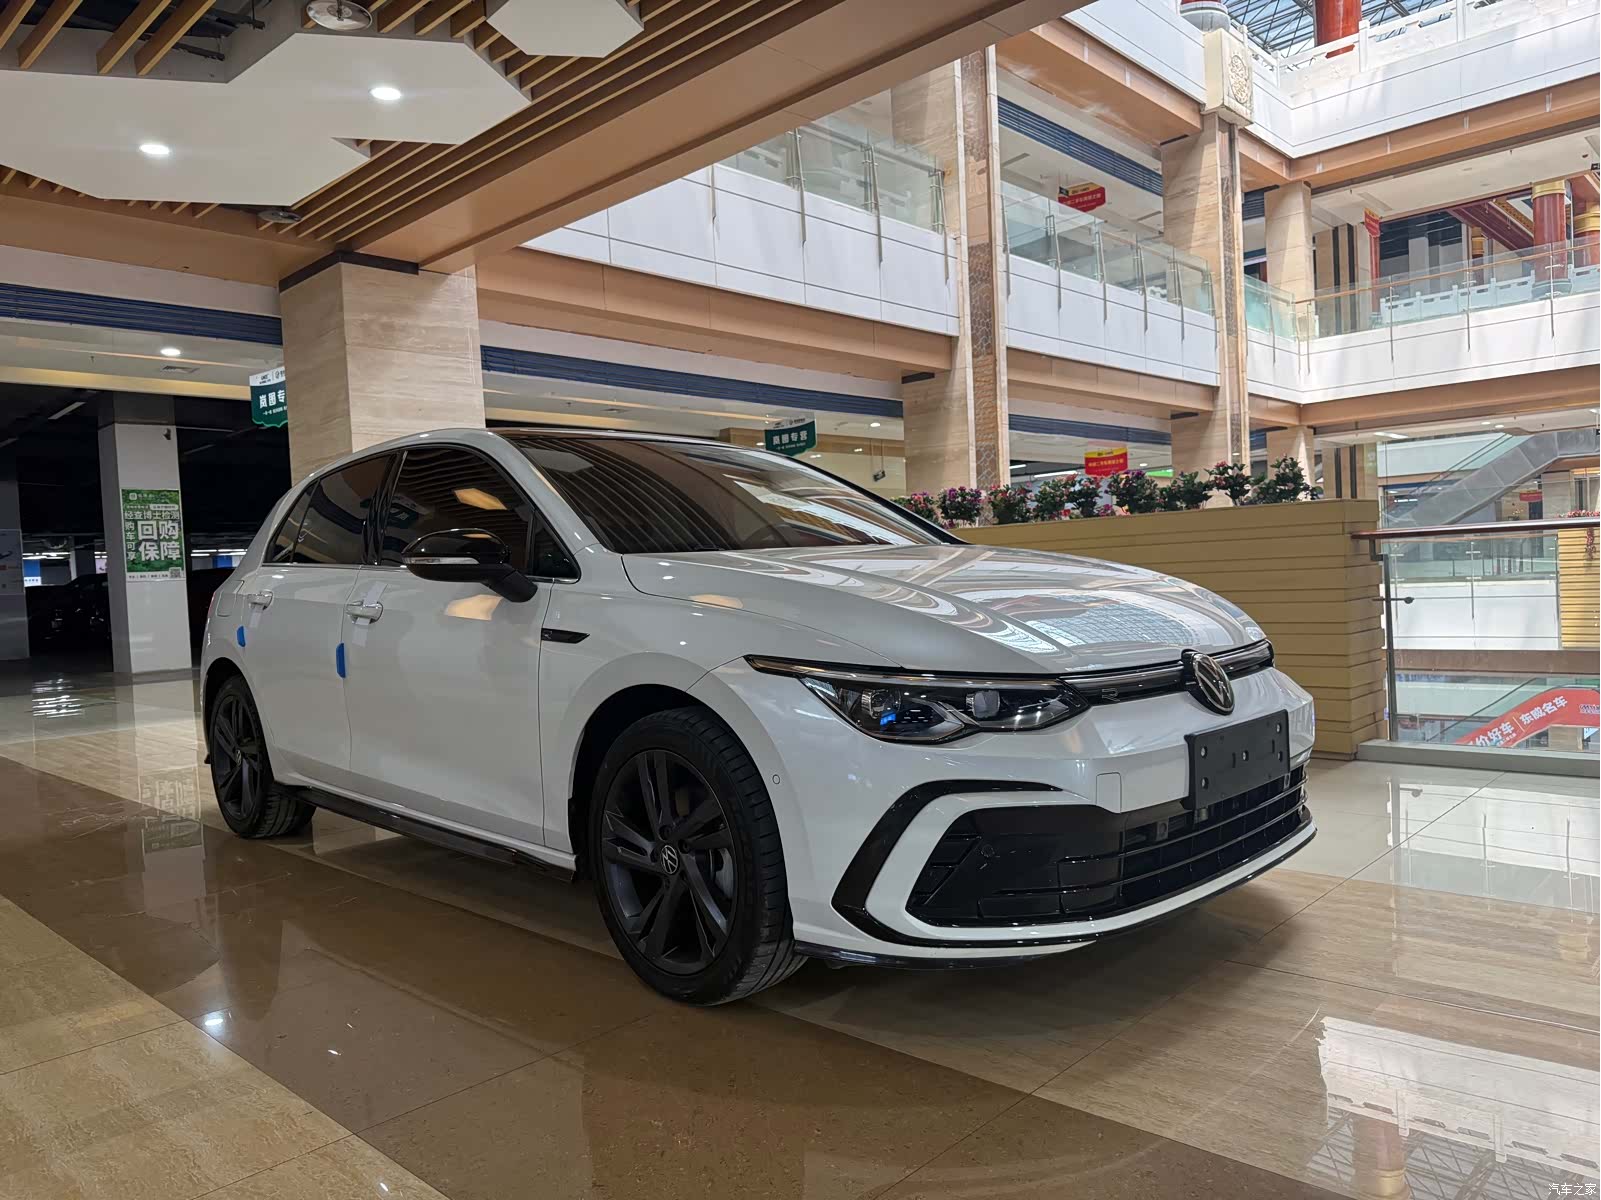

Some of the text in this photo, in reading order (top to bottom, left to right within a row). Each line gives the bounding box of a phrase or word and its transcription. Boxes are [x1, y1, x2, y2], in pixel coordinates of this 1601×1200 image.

[124, 510, 180, 520] 经查博士检测
[137, 520, 179, 540] 回购
[139, 541, 181, 561] 保障
[1467, 721, 1514, 747] 价好车
